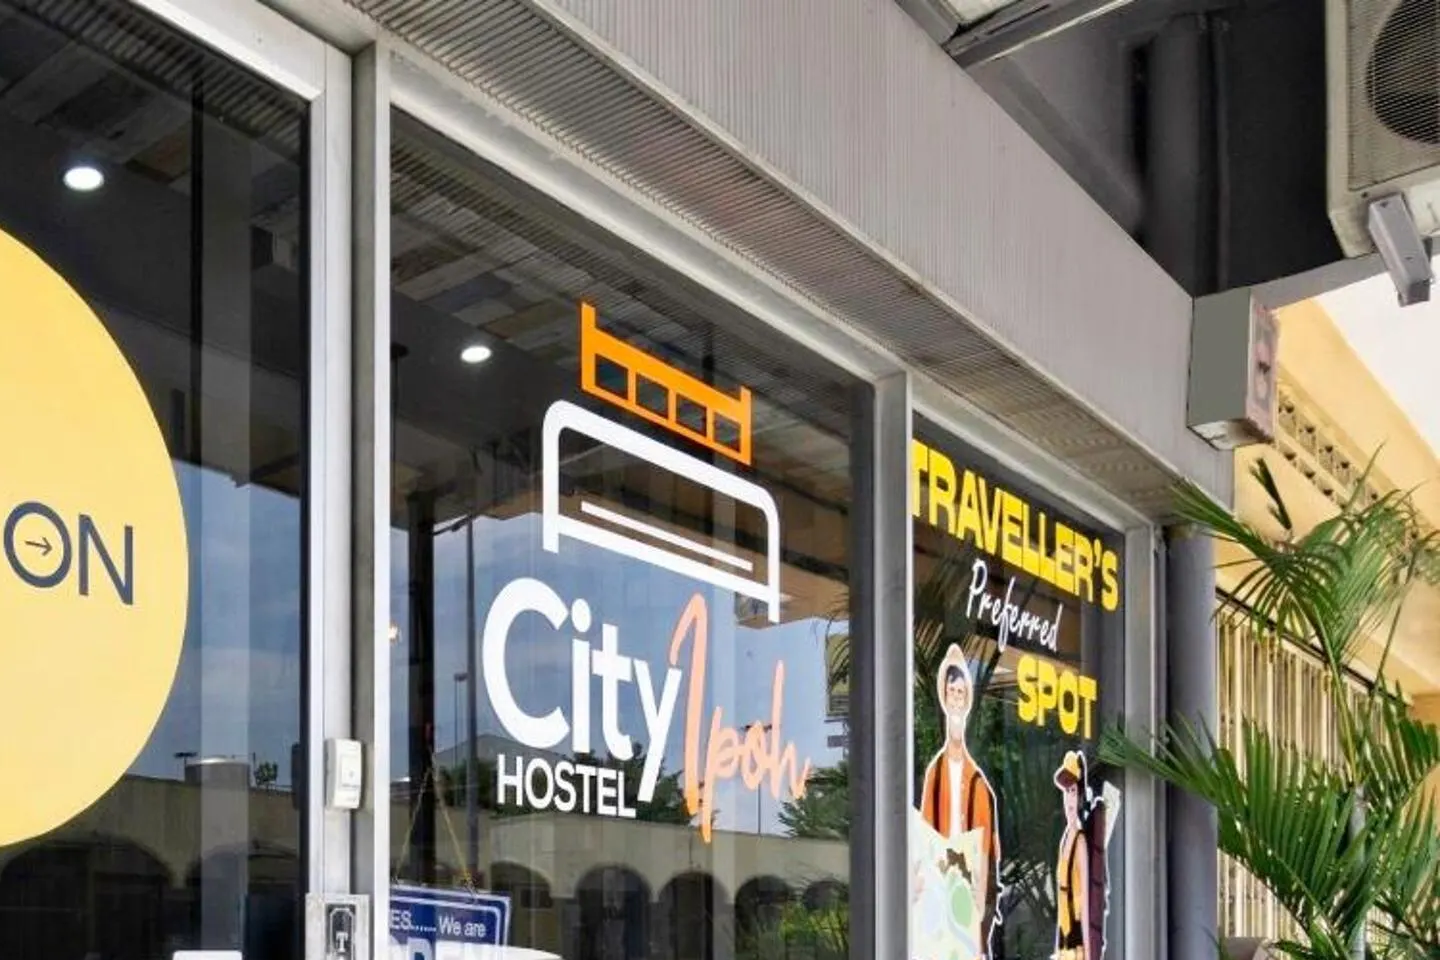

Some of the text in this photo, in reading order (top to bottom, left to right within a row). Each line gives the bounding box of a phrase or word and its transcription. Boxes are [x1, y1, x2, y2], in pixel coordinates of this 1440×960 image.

[4, 501, 134, 605] ON
[912, 438, 1119, 612] TRAVELLER'S
[966, 558, 1063, 653] Preferred
[482, 577, 812, 844] City Ipoh
[1017, 654, 1098, 740] SPOT
[497, 753, 637, 819] HOSTEL
[438, 915, 460, 936] We
[464, 921, 487, 938] are
